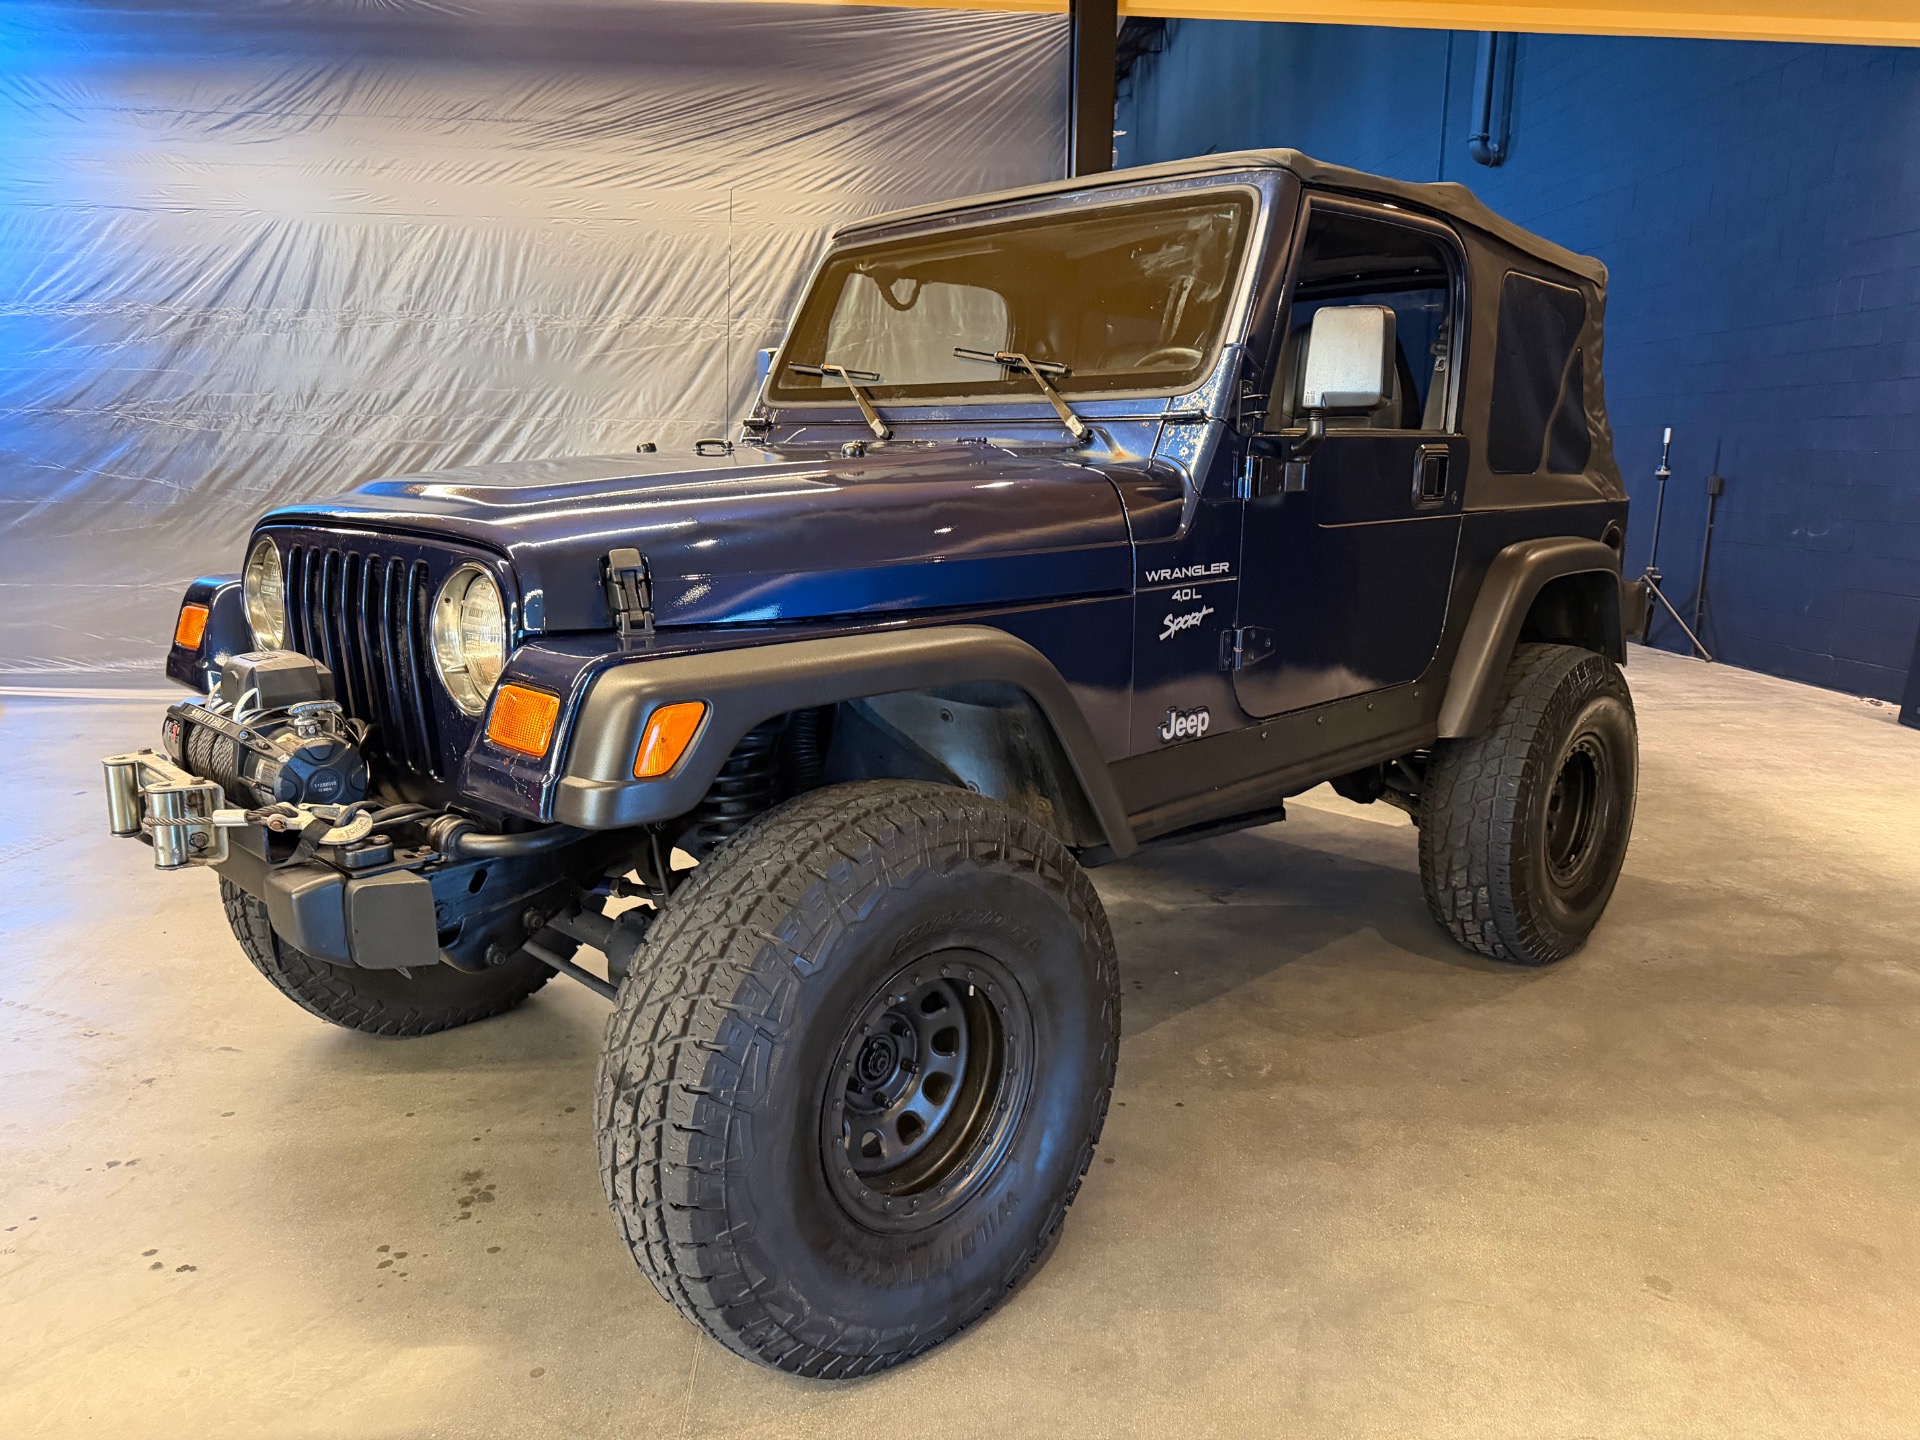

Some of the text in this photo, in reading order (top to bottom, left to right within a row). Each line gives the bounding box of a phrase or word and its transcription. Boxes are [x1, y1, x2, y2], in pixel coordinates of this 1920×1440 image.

[1145, 561, 1230, 583] WRANGLER
[189, 708, 230, 730] SMITTYBILT
[1159, 706, 1210, 743] Jeep
